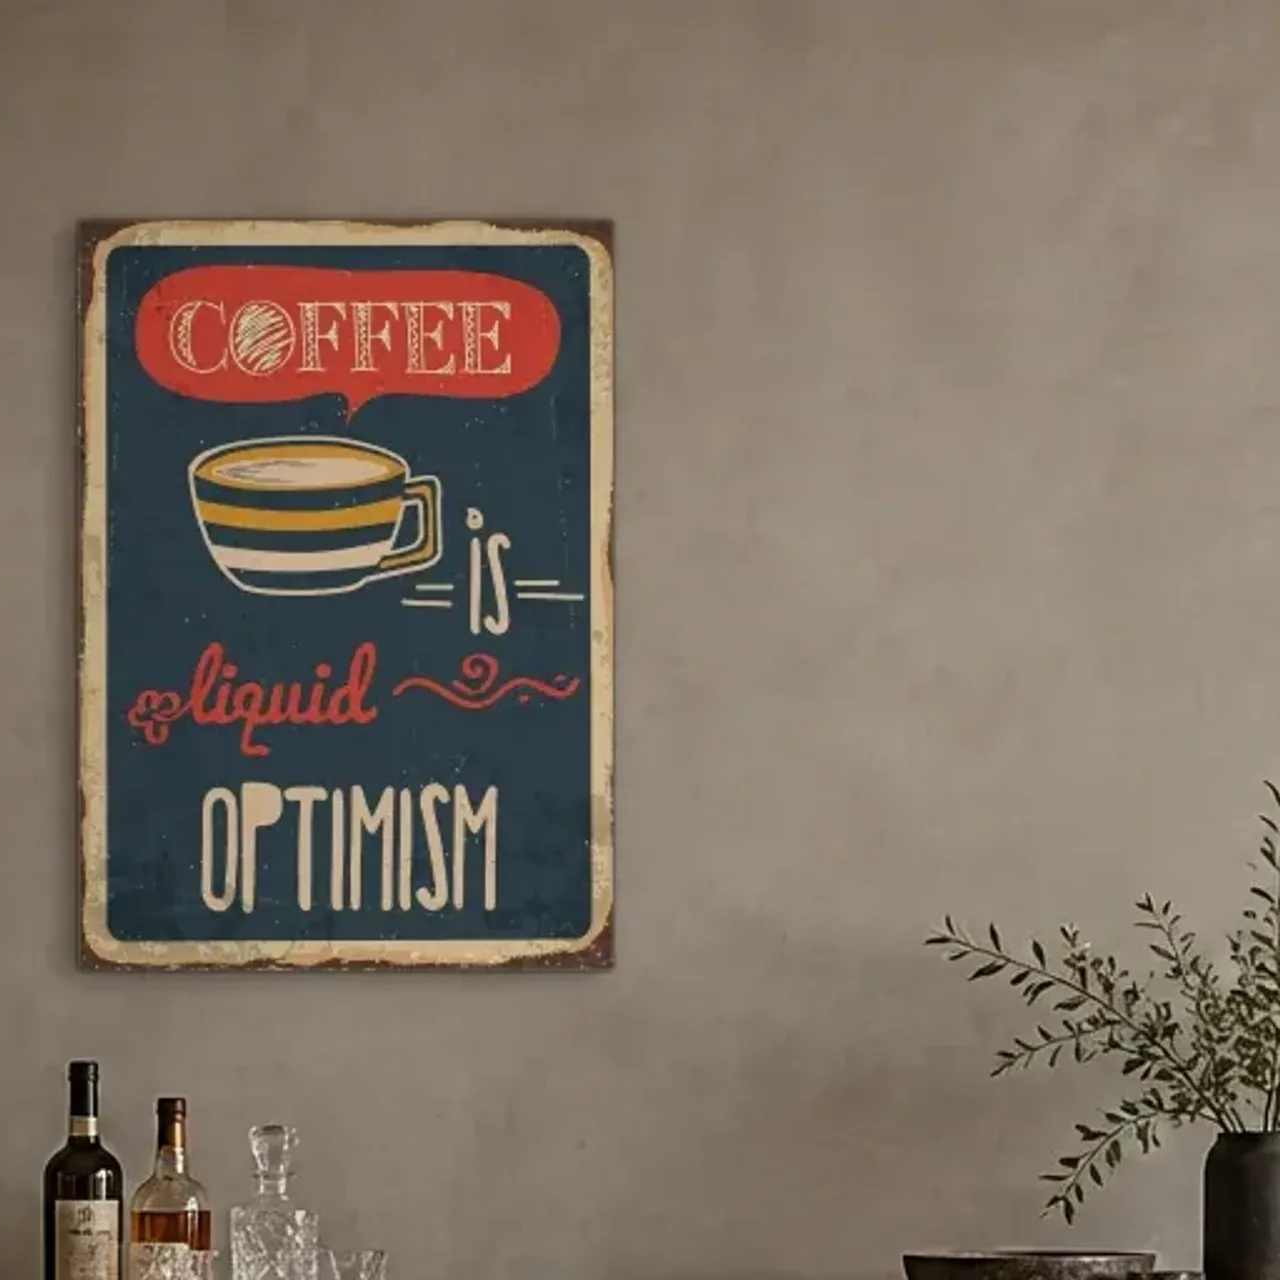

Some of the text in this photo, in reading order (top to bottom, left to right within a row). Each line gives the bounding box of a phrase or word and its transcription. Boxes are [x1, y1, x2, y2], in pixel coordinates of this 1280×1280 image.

[169, 300, 512, 376] COFFEE
[466, 507, 511, 635] is
[188, 643, 378, 756] liquid
[201, 781, 499, 913] OPTIMISM
